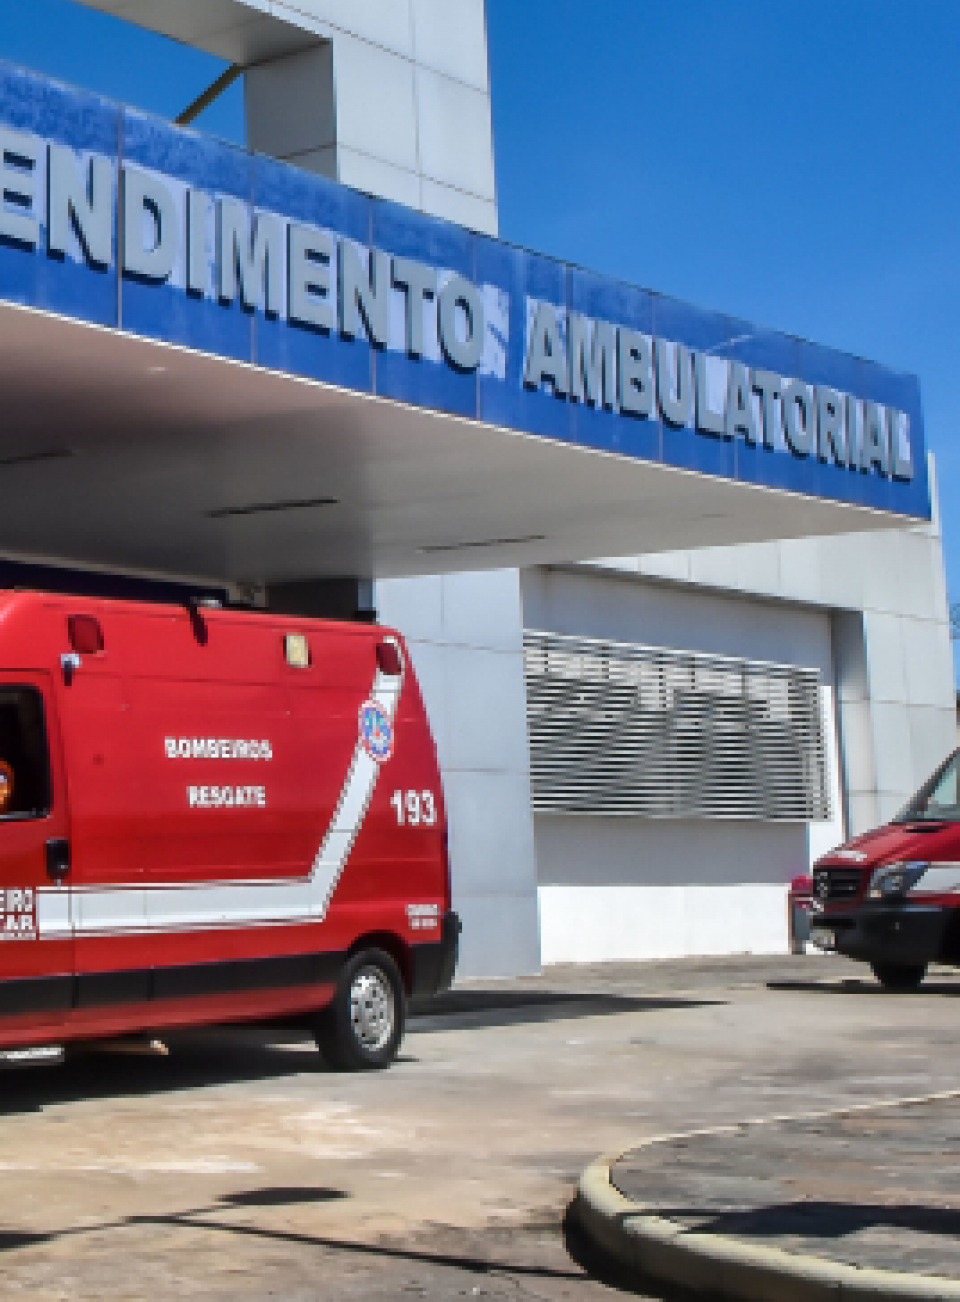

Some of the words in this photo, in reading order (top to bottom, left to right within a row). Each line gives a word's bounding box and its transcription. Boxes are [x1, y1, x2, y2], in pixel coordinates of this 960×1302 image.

[523, 301, 914, 482] AMBULATORIAL
[164, 736, 273, 761] BOMBEIROS
[186, 783, 267, 808] RESGATE
[391, 789, 437, 825] 193
